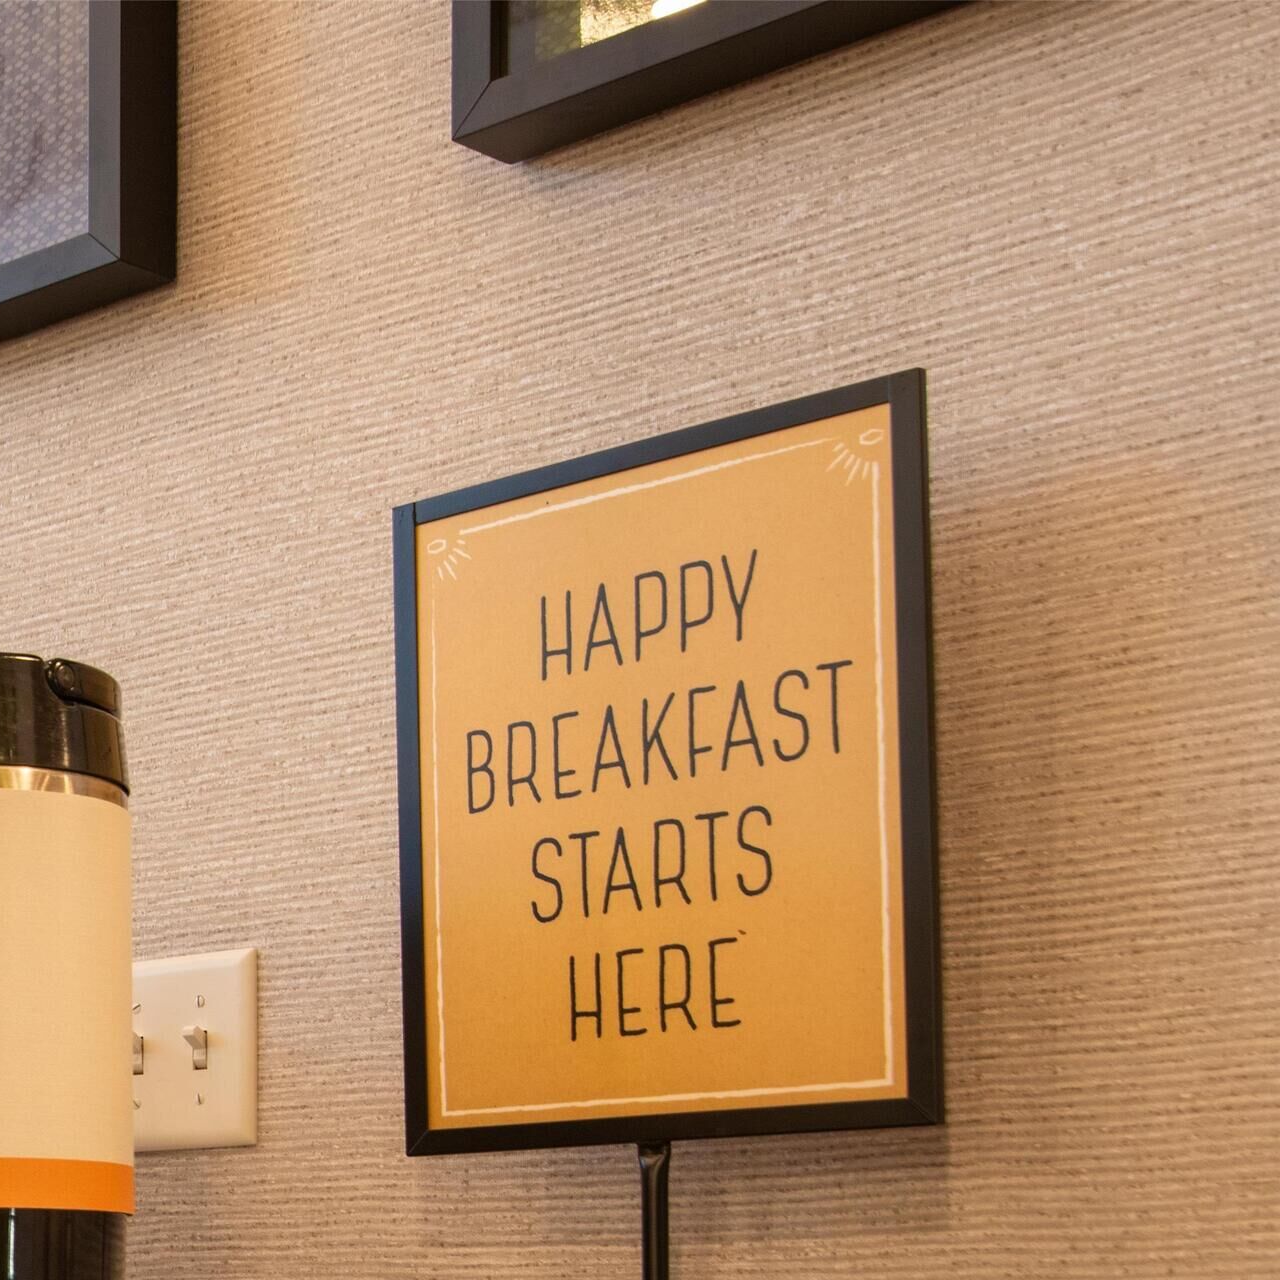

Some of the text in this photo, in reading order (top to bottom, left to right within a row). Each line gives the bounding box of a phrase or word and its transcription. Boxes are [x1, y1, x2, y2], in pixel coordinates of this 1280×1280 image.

[540, 548, 758, 682] HAPPY
[465, 658, 854, 815] BREAKFAST
[530, 804, 774, 924] STARTS
[568, 936, 743, 1042] HERE
